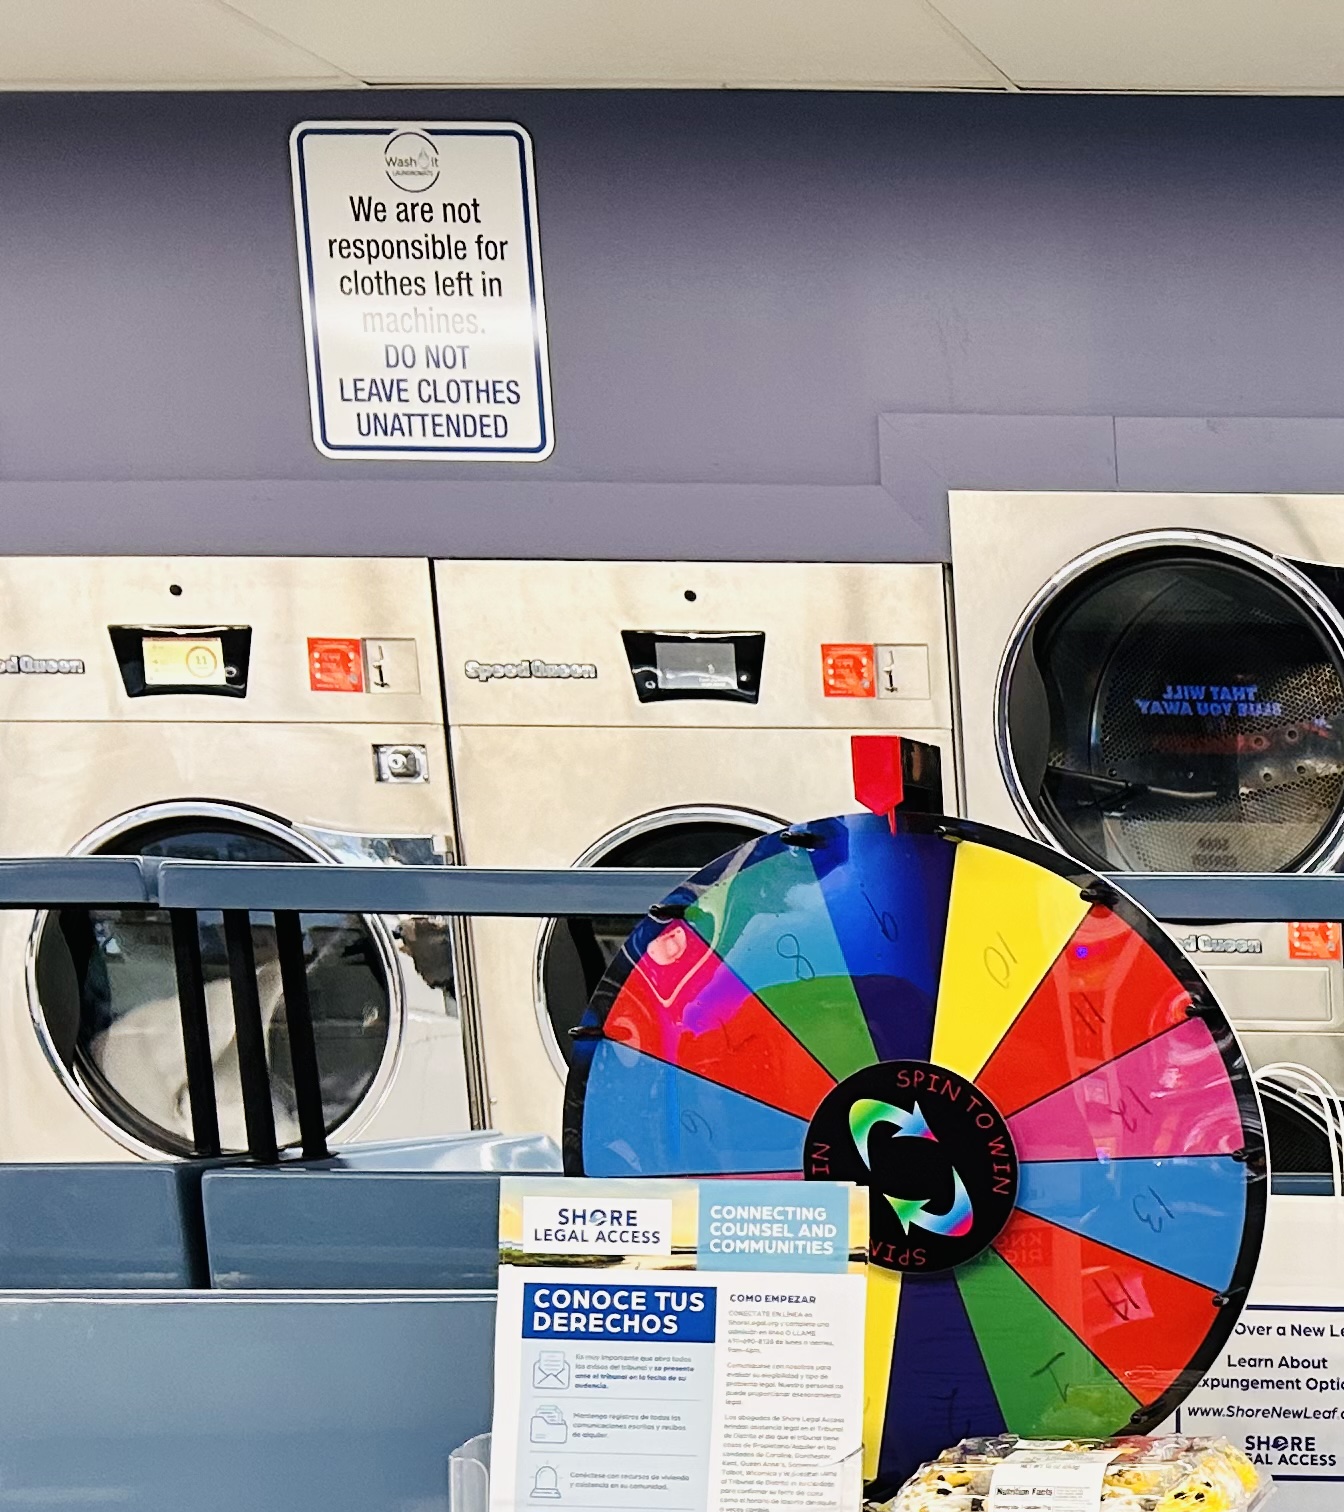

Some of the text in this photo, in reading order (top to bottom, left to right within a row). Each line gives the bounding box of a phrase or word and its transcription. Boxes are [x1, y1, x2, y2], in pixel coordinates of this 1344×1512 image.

[386, 157, 417, 168] Wash
[350, 196, 482, 224] We are not
[328, 234, 509, 265] responsible for
[340, 270, 502, 297] clothes left in
[362, 306, 486, 335] machines.
[384, 343, 470, 370] DO NOT
[339, 378, 521, 405] LEAVE CLOTHES
[356, 412, 509, 439] UNATTENDED
[465, 659, 598, 683] Speed Queen
[1197, 934, 1262, 954] Queen
[896, 1070, 1012, 1195] SPIN TO WIN
[558, 1208, 638, 1227] SHORE
[709, 1205, 827, 1221] CONNECTING
[534, 1228, 661, 1244] LEGAL ACCESS
[709, 1222, 837, 1238] COUNSEL AND
[709, 1238, 833, 1255] COMMUNITIES
[533, 1288, 705, 1312] CONOCE TUS
[730, 1294, 817, 1304] COMO EMPEZAR
[532, 1312, 678, 1335] DERECHOS
[1235, 1323, 1272, 1337] Over
[1276, 1327, 1286, 1337] a
[1291, 1324, 1325, 1337] New
[1227, 1355, 1328, 1369] Learn About
[1198, 1378, 1301, 1391] xpungement
[1245, 1435, 1316, 1452] SHORE
[1278, 1453, 1336, 1466] ACCESS
